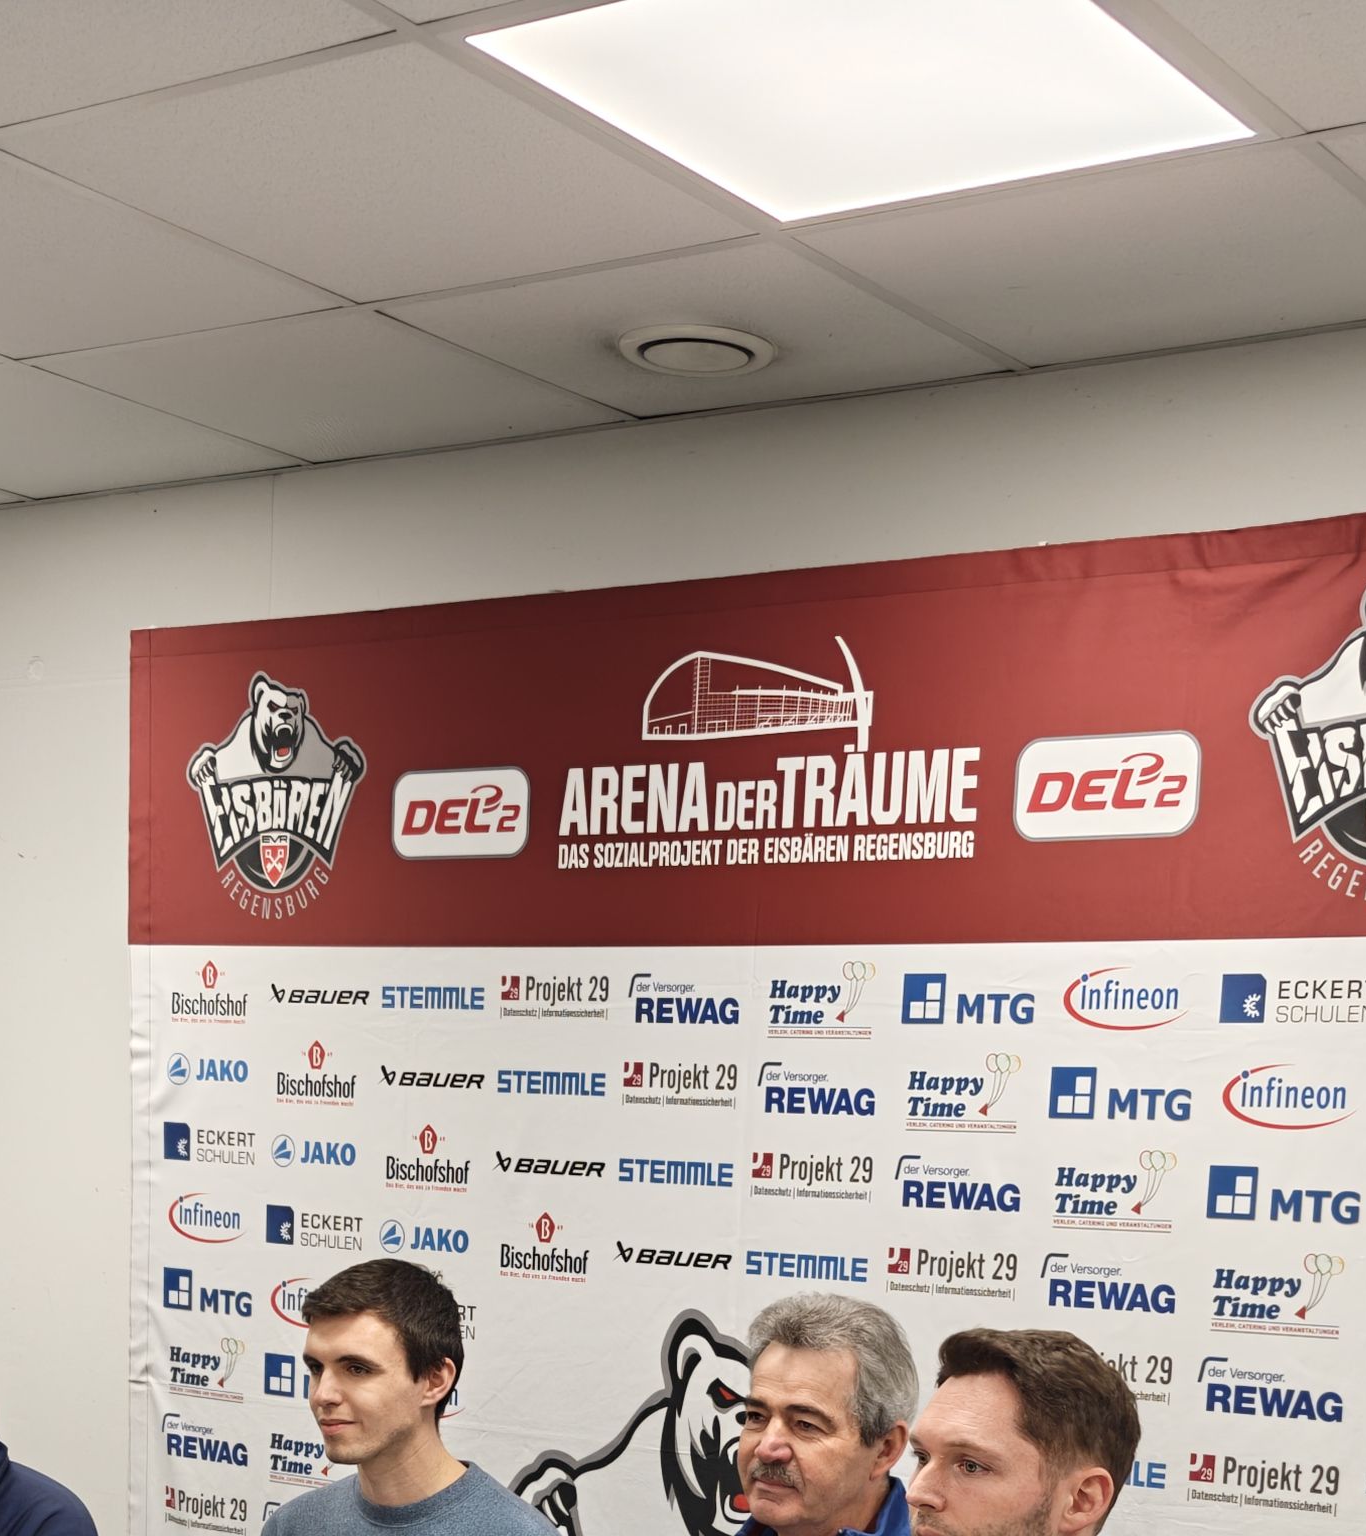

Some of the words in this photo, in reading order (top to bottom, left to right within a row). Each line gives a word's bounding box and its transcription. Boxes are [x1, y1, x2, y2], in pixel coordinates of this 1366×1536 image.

[559, 761, 706, 836] ARENA
[716, 780, 776, 830] DER
[776, 745, 980, 829] TRÄUME
[206, 777, 349, 857] EISBÄREN
[557, 844, 587, 869] DAS
[593, 839, 721, 868] SOZIALPROJEKT
[727, 838, 759, 864] DER
[763, 833, 848, 864] EISBÄREN
[854, 831, 973, 861] REGENSBURG
[220, 869, 329, 921] REGENSBURG
[382, 986, 484, 1010] STEMMLE
[526, 976, 582, 1006] Projekt
[588, 976, 609, 1001] 29
[636, 981, 650, 993] der
[769, 980, 841, 1003] Happy
[172, 992, 248, 1016] Bischofshof
[636, 998, 739, 1024] REWAG
[769, 1005, 824, 1024] Time
[957, 993, 1035, 1024] MTG
[196, 1059, 248, 1083] JAKO
[497, 1070, 606, 1096] STEMMLE
[649, 1062, 709, 1094] Projekt
[715, 1064, 737, 1090] 29
[766, 1070, 781, 1082] der
[907, 1071, 984, 1096] Happy
[277, 1072, 356, 1098] Bischofshof
[764, 1087, 875, 1116] REWAG
[907, 1096, 966, 1118] Time
[1107, 1088, 1192, 1121] MTG
[197, 1129, 255, 1147] ECKERT
[196, 1148, 255, 1165] SCHULEN
[300, 1141, 356, 1166] JAKO
[386, 1156, 471, 1184] Bischofshof
[619, 1158, 733, 1187] STEMMLE
[779, 1153, 843, 1186] Projekt
[849, 1156, 873, 1183] 29
[904, 1163, 919, 1175] der
[1055, 1167, 1137, 1194] Happy
[902, 1180, 1021, 1212] REWAG
[1055, 1193, 1118, 1215] Time
[1270, 1189, 1361, 1225] MTG
[301, 1213, 363, 1232] ECKERT
[300, 1233, 363, 1251] SCHULEN
[410, 1226, 469, 1254] JAKO
[500, 1243, 590, 1275] Bischofshof
[746, 1251, 867, 1282] STEMMLE
[917, 1249, 985, 1283] Projekt
[992, 1253, 1017, 1281] 29
[1050, 1262, 1066, 1274] der
[1213, 1268, 1301, 1298] Happy
[200, 1287, 252, 1317] MTG
[1049, 1280, 1175, 1313] REWAG
[1213, 1295, 1281, 1319] Time
[170, 1346, 221, 1371] Happy
[1145, 1355, 1173, 1385] 29
[170, 1367, 209, 1387] Time
[1208, 1366, 1225, 1379] der
[1206, 1383, 1343, 1422] REWAG
[167, 1433, 248, 1466] REWAG
[270, 1433, 324, 1459] Happy
[270, 1455, 312, 1475] Time
[1222, 1456, 1302, 1493] Projekt
[1311, 1464, 1340, 1496] 29
[178, 1490, 225, 1519] Projekt
[230, 1498, 247, 1521] 29
[1191, 1489, 1238, 1505] Datenschutz
